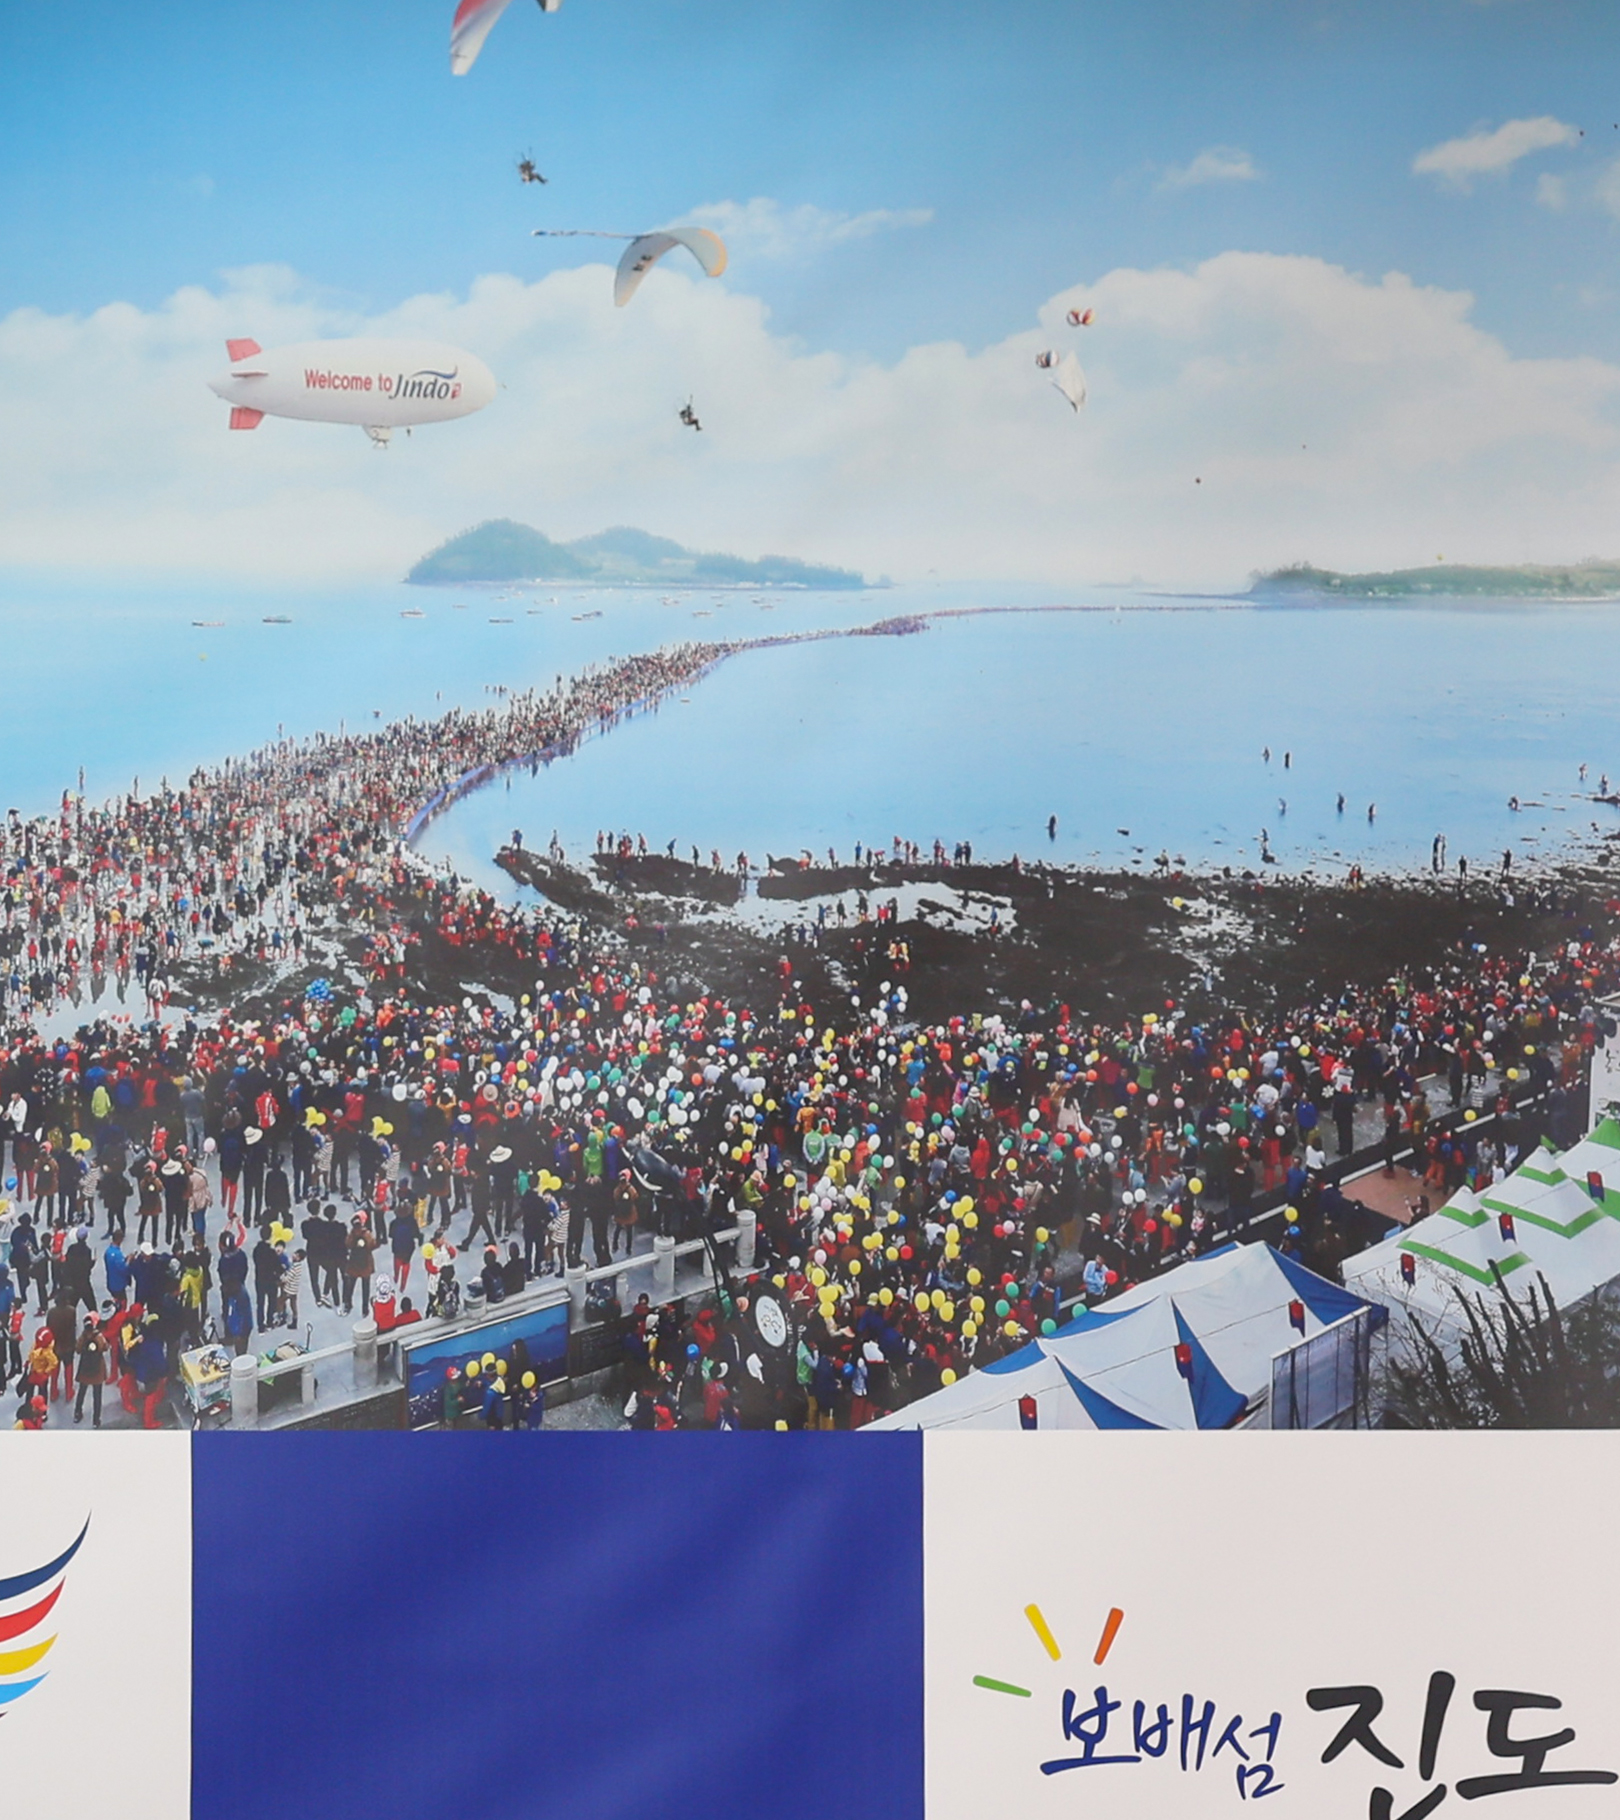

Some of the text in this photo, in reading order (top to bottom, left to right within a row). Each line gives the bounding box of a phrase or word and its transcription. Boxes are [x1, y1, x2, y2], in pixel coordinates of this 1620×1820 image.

[304, 369, 372, 392] Welcome
[378, 373, 392, 393] to
[388, 373, 450, 399] Jindo
[1040, 1686, 1285, 1800] 보배섬
